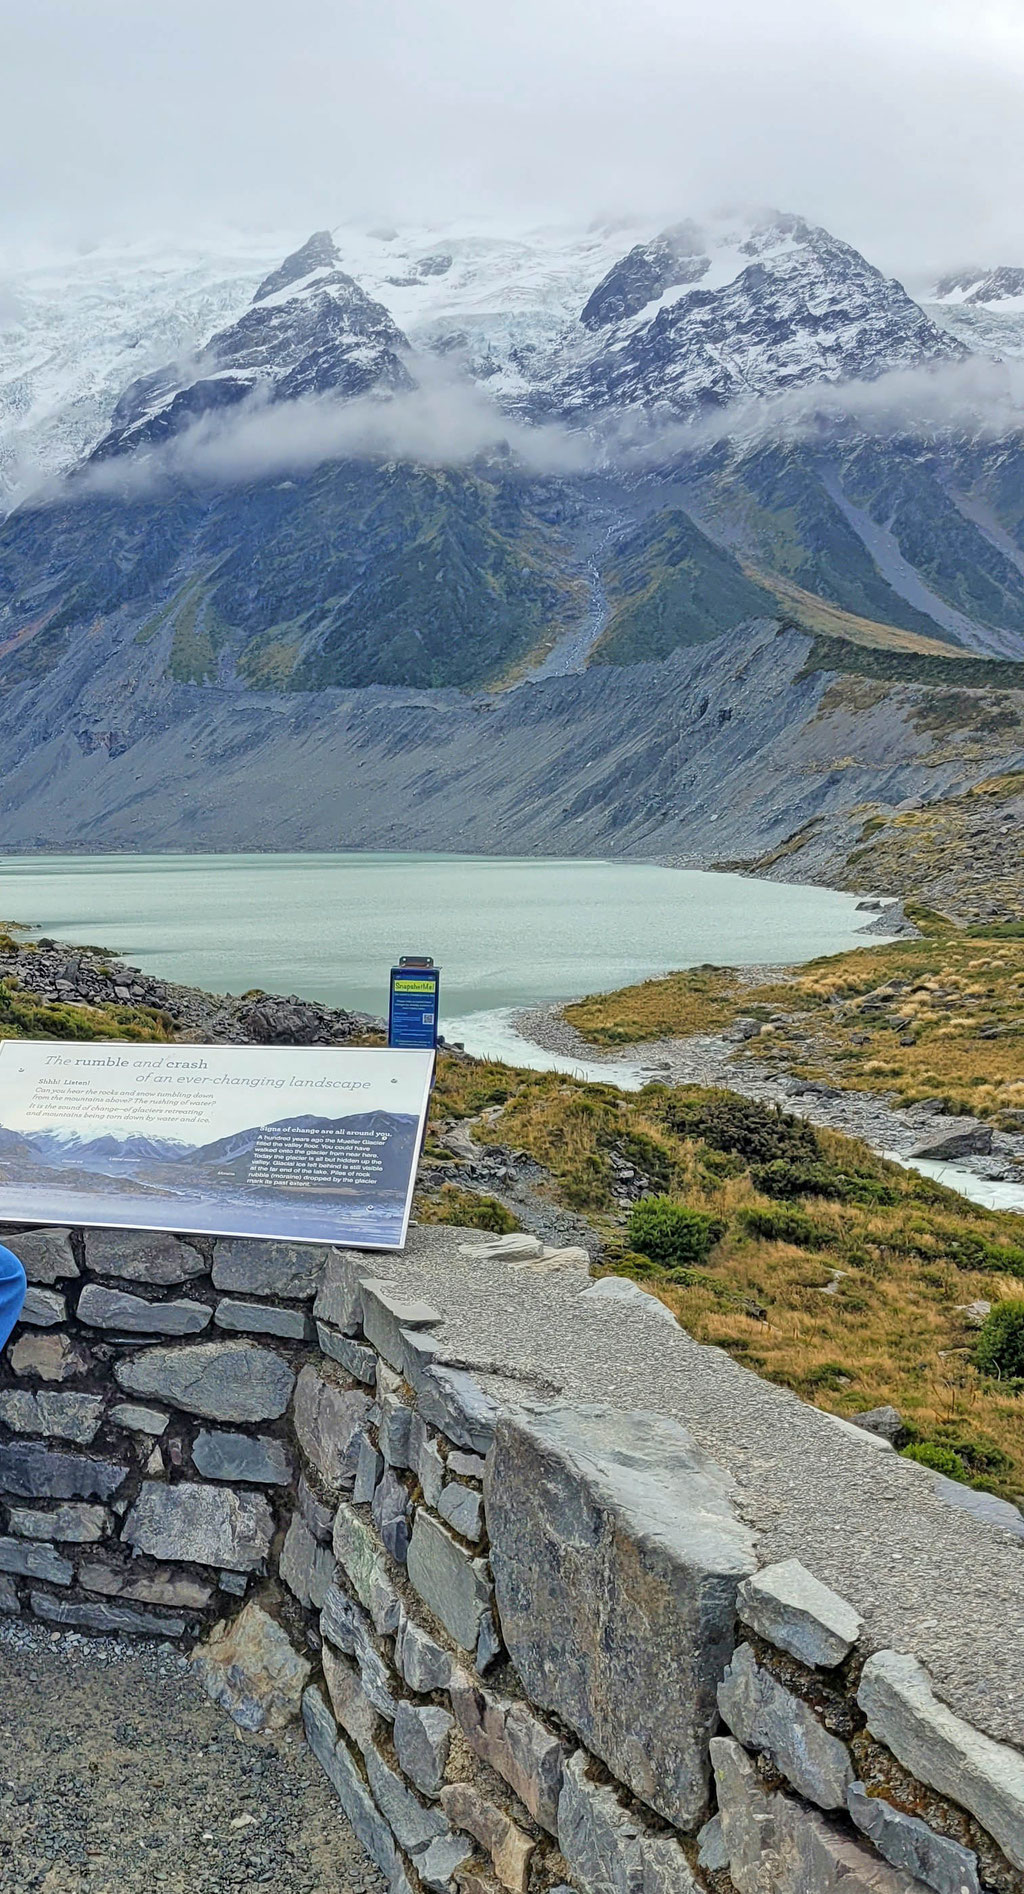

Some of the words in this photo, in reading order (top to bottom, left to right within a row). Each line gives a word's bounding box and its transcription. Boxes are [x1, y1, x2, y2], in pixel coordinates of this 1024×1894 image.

[45, 1055, 71, 1066] The
[75, 1057, 129, 1067] rumble
[133, 1058, 163, 1068] and
[166, 1059, 207, 1069] crash
[136, 1072, 153, 1082] of
[154, 1075, 172, 1083] an
[177, 1074, 285, 1088] ever-changing
[289, 1076, 371, 1091] landscape
[157, 1091, 191, 1099] tumbling
